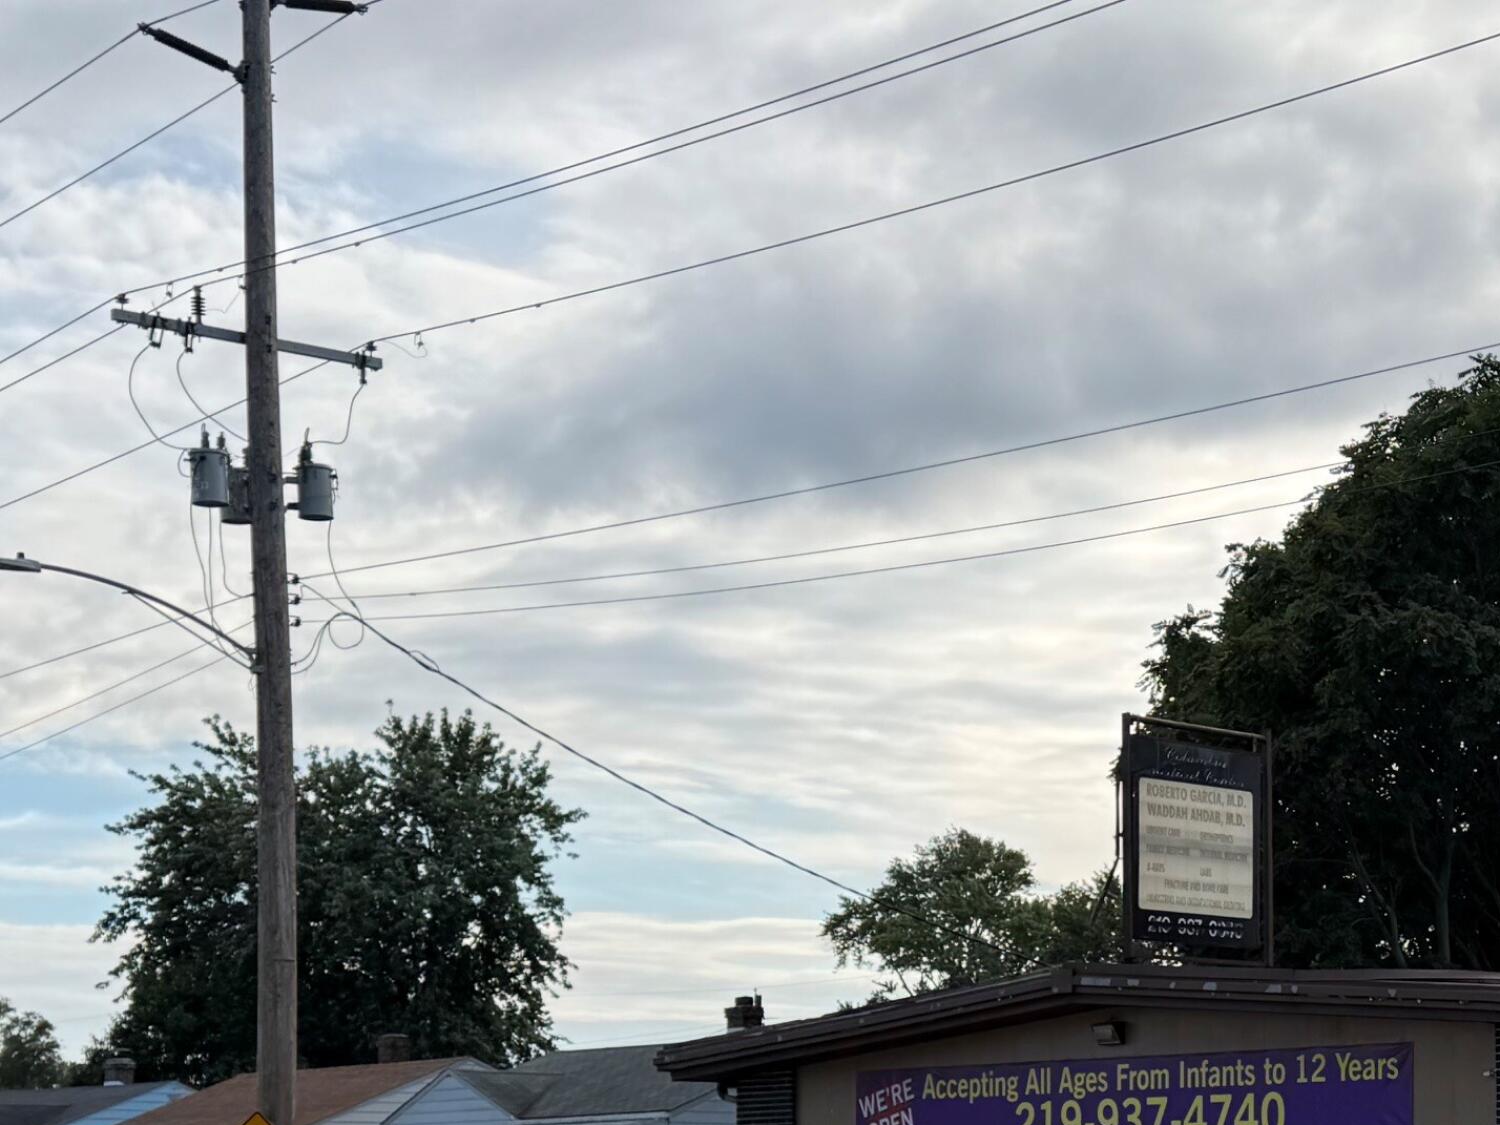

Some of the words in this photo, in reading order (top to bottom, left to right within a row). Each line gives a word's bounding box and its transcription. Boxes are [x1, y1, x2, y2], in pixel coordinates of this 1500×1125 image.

[1146, 783, 1188, 801] ROBERTO
[1226, 793, 1247, 809] M.D.
[1147, 802, 1188, 820] WADDAH
[1225, 812, 1246, 827] M.D.
[921, 1072, 1019, 1105] Accepting
[1025, 1066, 1051, 1095] All
[1059, 1065, 1109, 1100] Ages
[1116, 1062, 1170, 1092] From
[1179, 1058, 1256, 1089] Infants
[1263, 1057, 1287, 1086] to
[1295, 1053, 1327, 1083] 12
[1335, 1052, 1400, 1082] Years
[858, 1078, 916, 1119] WE'RE
